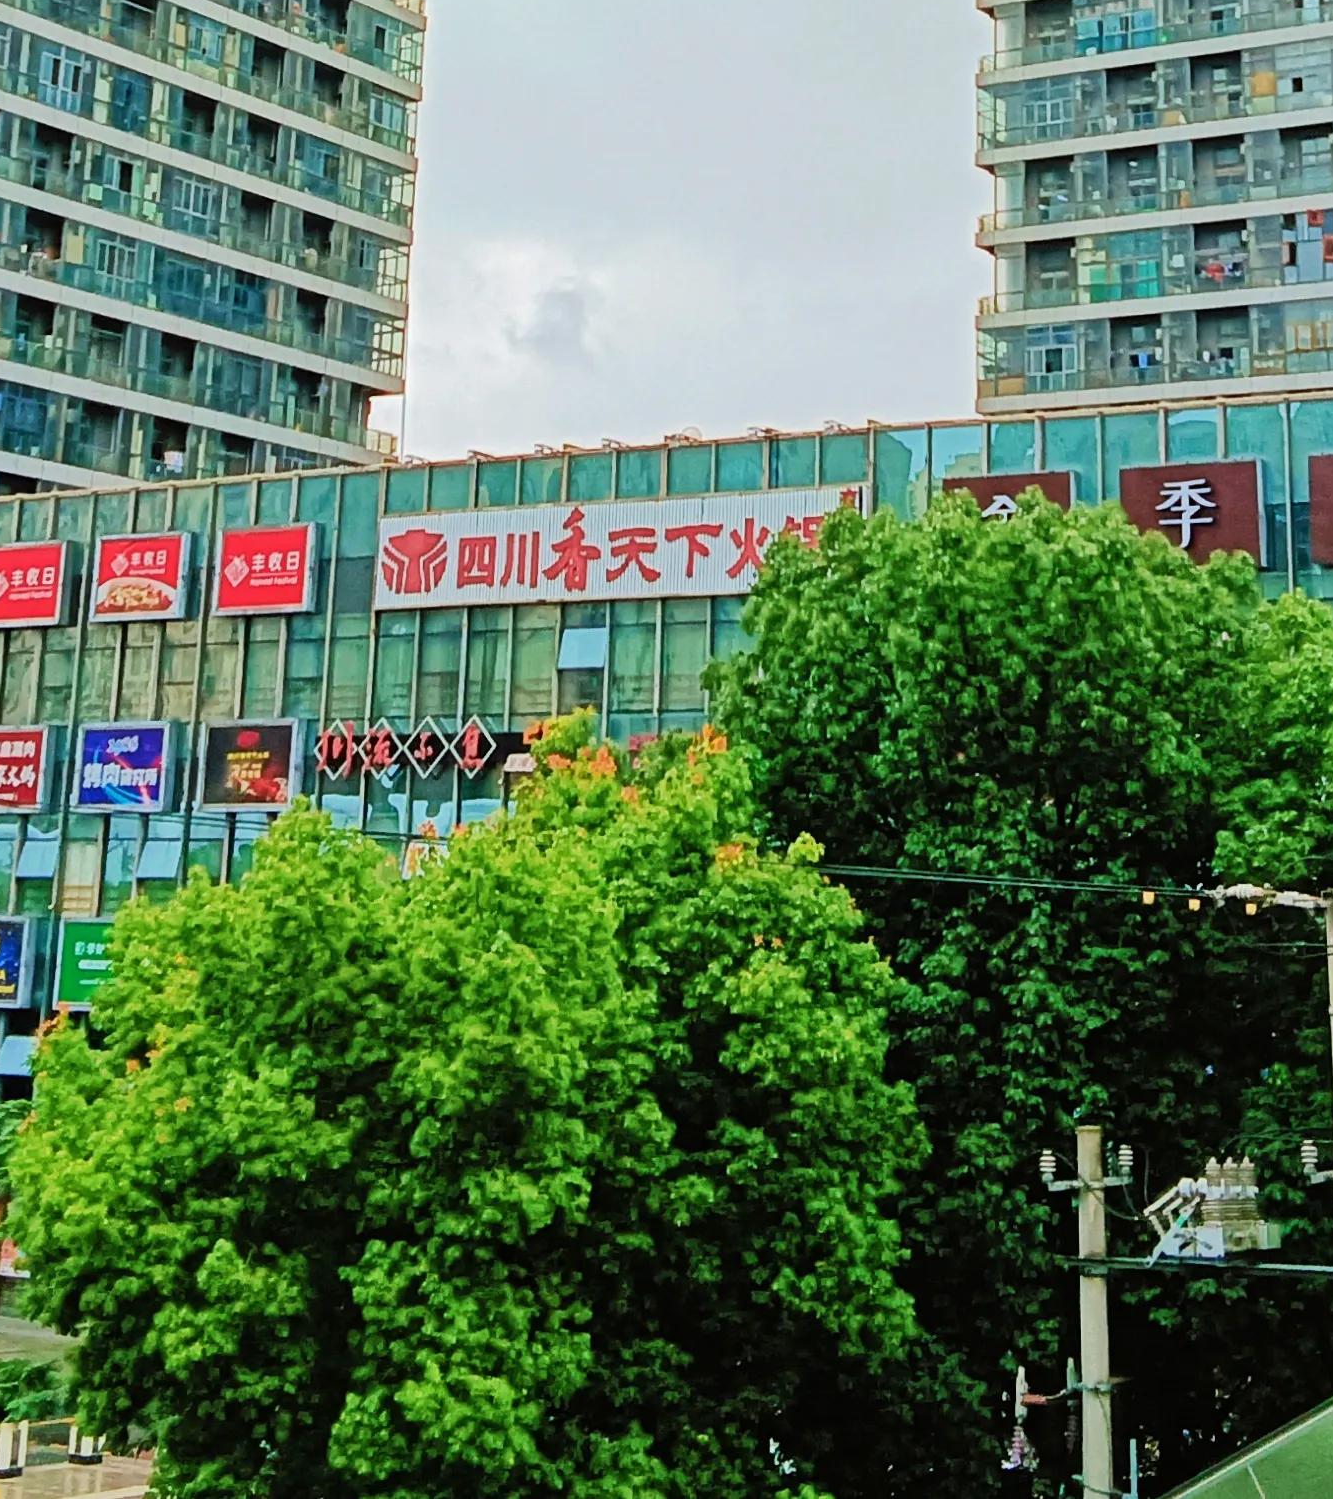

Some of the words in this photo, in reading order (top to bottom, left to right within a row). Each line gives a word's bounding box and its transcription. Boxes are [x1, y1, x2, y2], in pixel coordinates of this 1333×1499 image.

[130, 549, 167, 567] 丰收日
[251, 551, 300, 572] 丰收日
[10, 566, 55, 587] 丰收日
[316, 720, 485, 778] 川流不息
